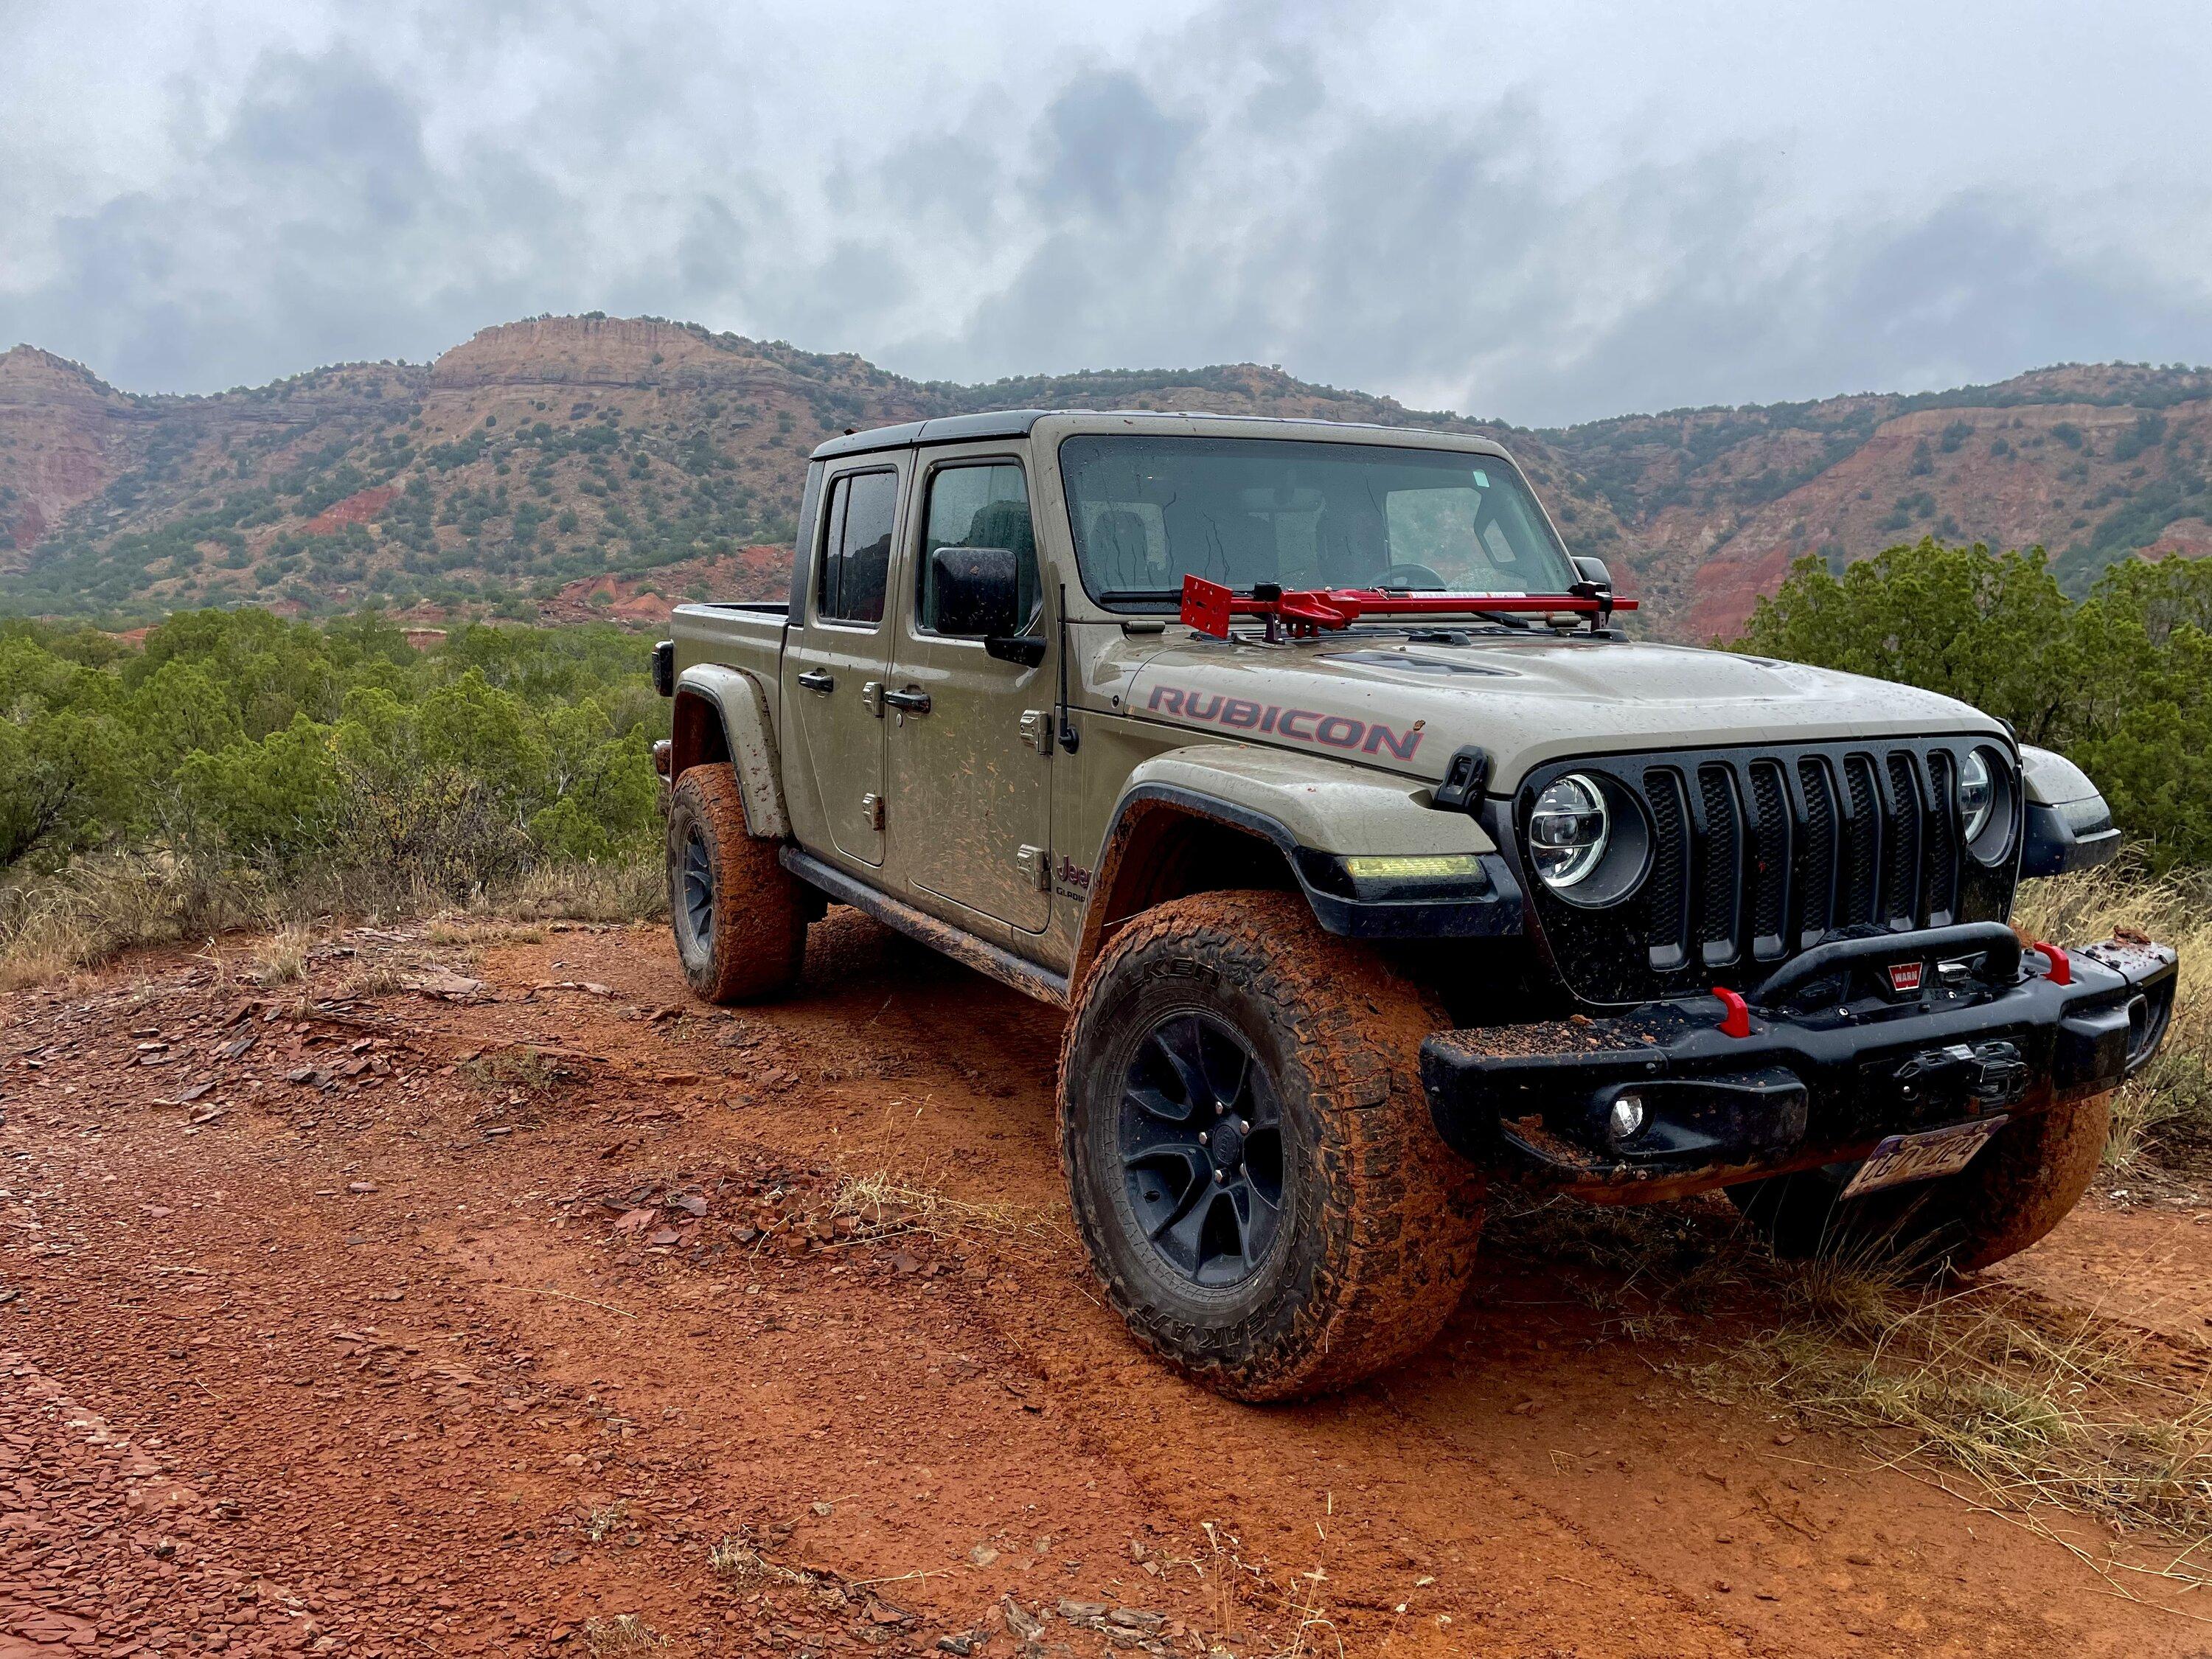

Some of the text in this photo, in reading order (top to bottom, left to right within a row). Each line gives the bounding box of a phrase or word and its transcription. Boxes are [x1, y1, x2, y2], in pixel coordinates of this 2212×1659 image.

[1147, 685, 1425, 762] RUBICON
[1091, 956, 1221, 1038] FALKEN
[1895, 970, 1918, 983] WARN
